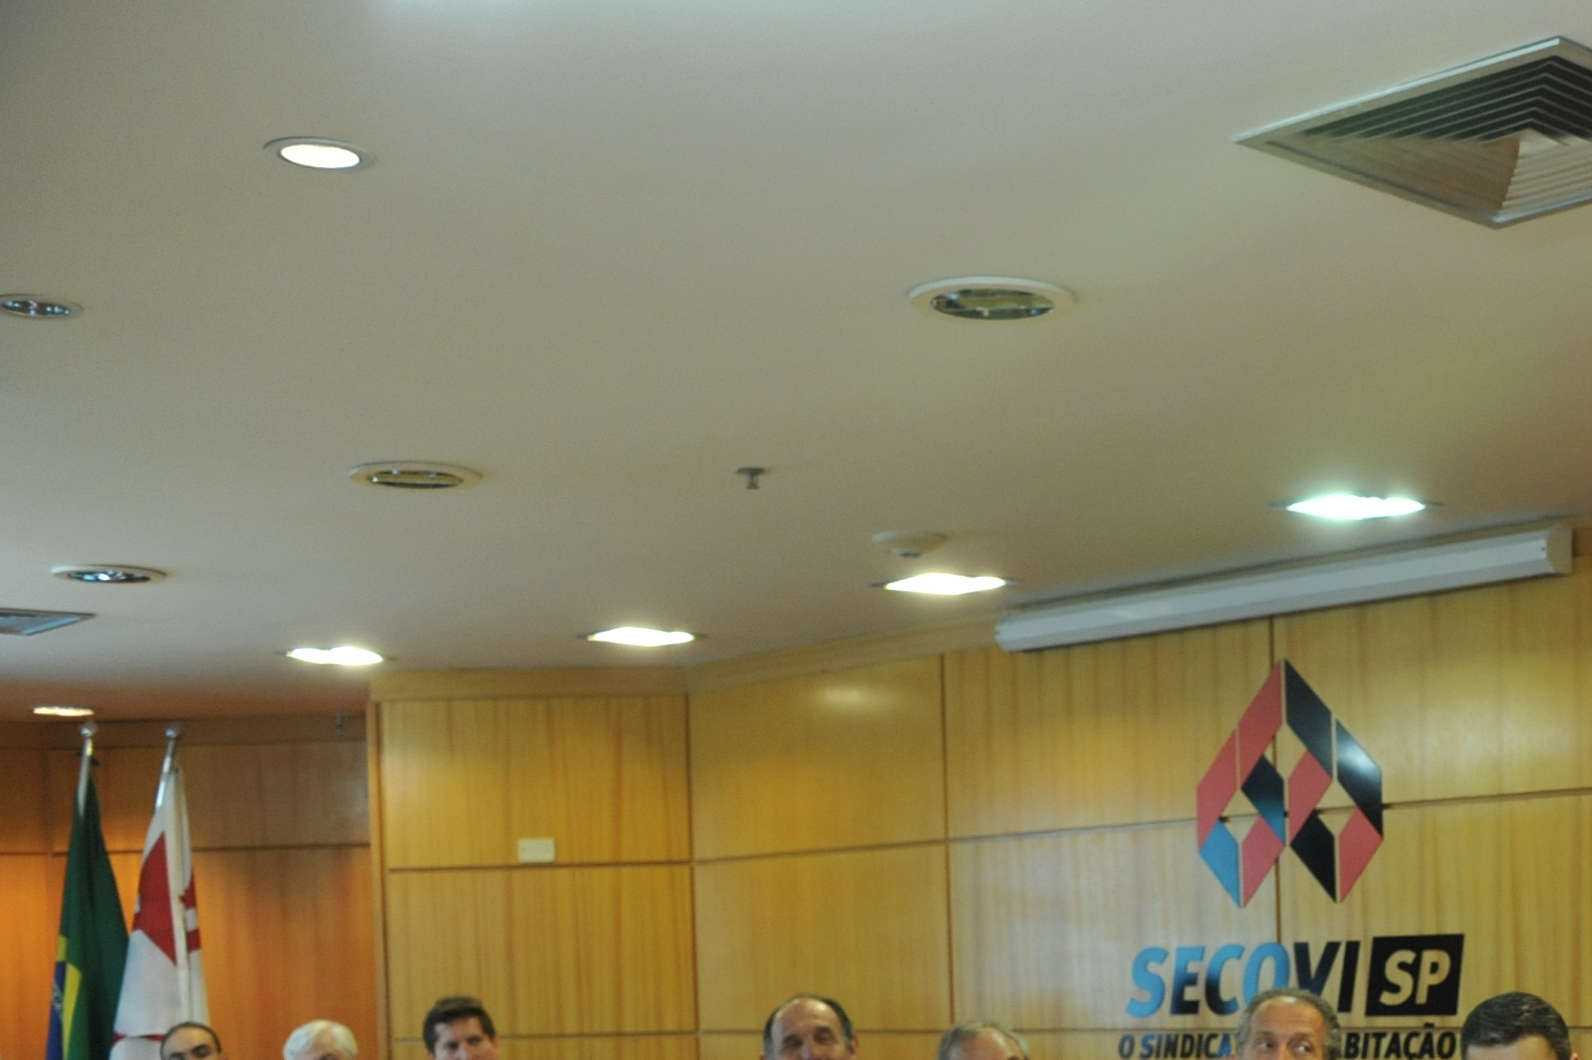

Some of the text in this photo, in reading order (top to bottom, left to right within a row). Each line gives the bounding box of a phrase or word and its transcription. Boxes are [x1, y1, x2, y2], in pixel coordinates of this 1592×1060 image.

[1125, 940, 1455, 1018] SECOVI SP
[1118, 1032, 1135, 1060] O
[1139, 1032, 1233, 1060] SINDICA
